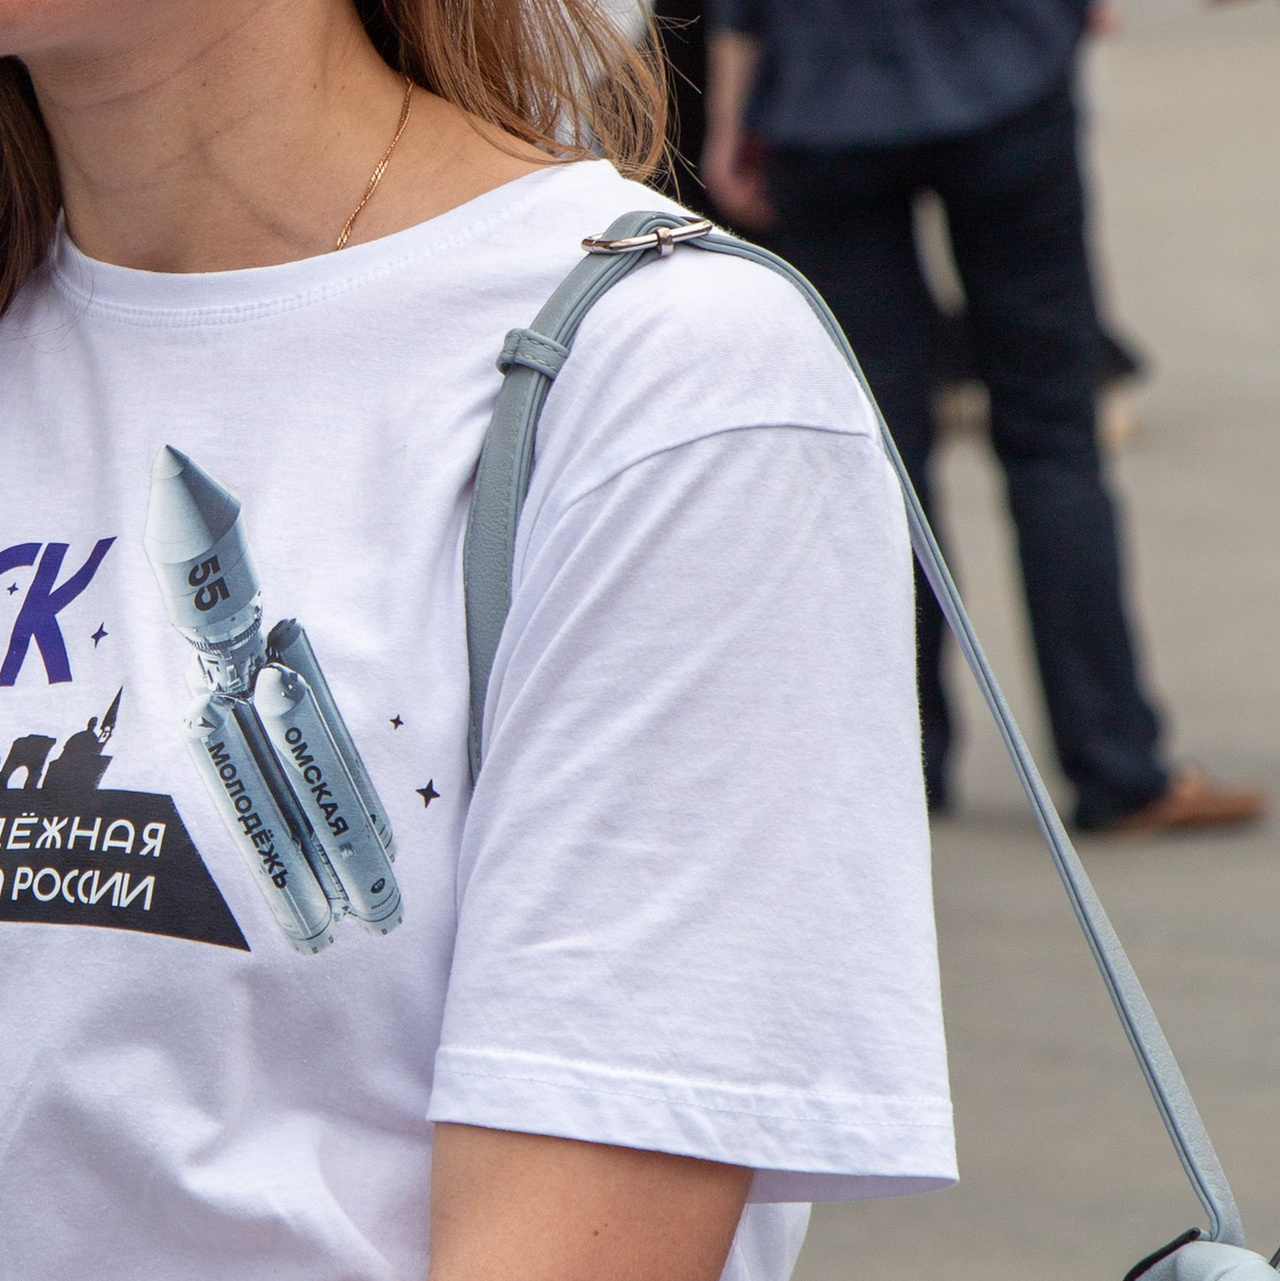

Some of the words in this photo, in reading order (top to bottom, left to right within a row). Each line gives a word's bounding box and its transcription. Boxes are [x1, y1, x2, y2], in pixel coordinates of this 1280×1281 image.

[187, 554, 231, 612] 55
[207, 740, 289, 890] МОЛОДЁЖЬ
[284, 726, 350, 837] ОМСКАЯ
[11, 866, 156, 911] РОССИИ
